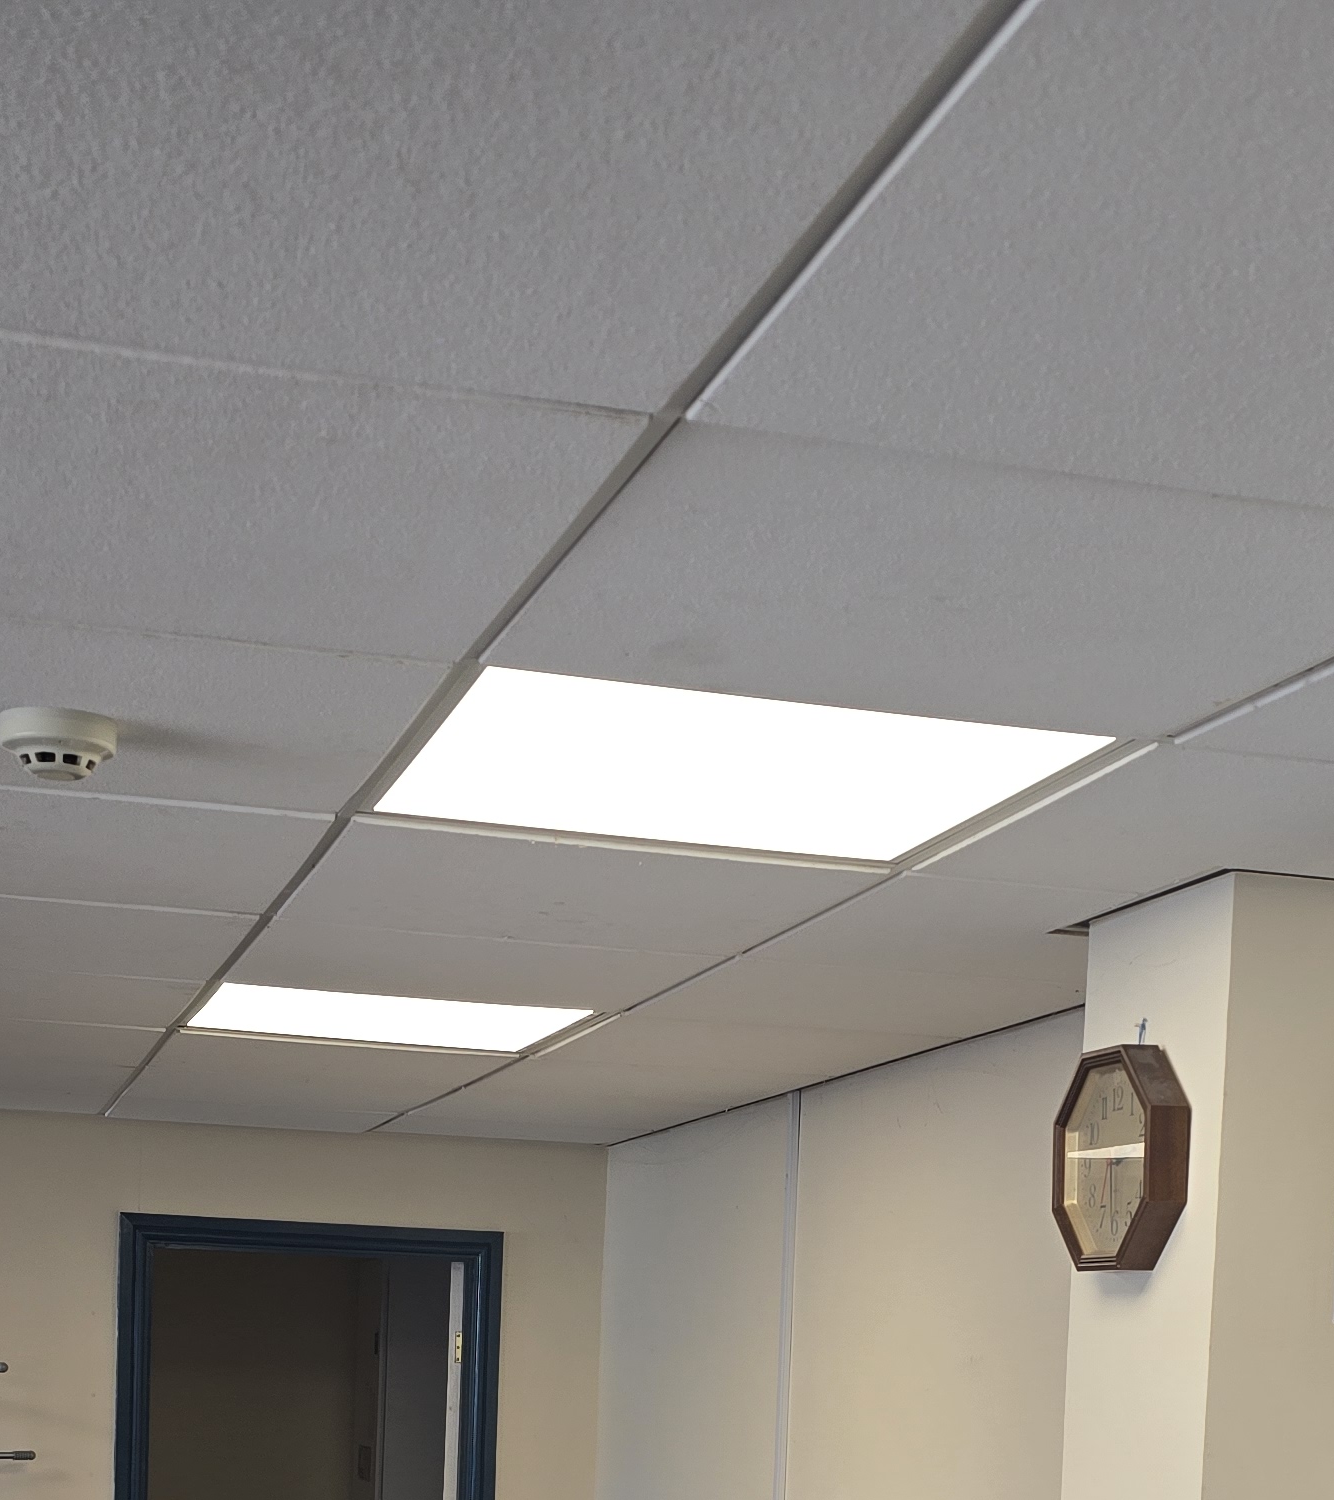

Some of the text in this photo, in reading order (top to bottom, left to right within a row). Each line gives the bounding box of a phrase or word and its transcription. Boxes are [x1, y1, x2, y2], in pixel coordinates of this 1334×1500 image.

[1101, 1097, 1108, 1121] 11
[1112, 1086, 1124, 1111] 12
[1129, 1092, 1134, 1116] 1
[1089, 1122, 1100, 1146] 10
[1088, 1184, 1097, 1208] 8
[1099, 1205, 1107, 1229] 7
[1110, 1210, 1119, 1236] 6
[1124, 1202, 1133, 1227] 5
